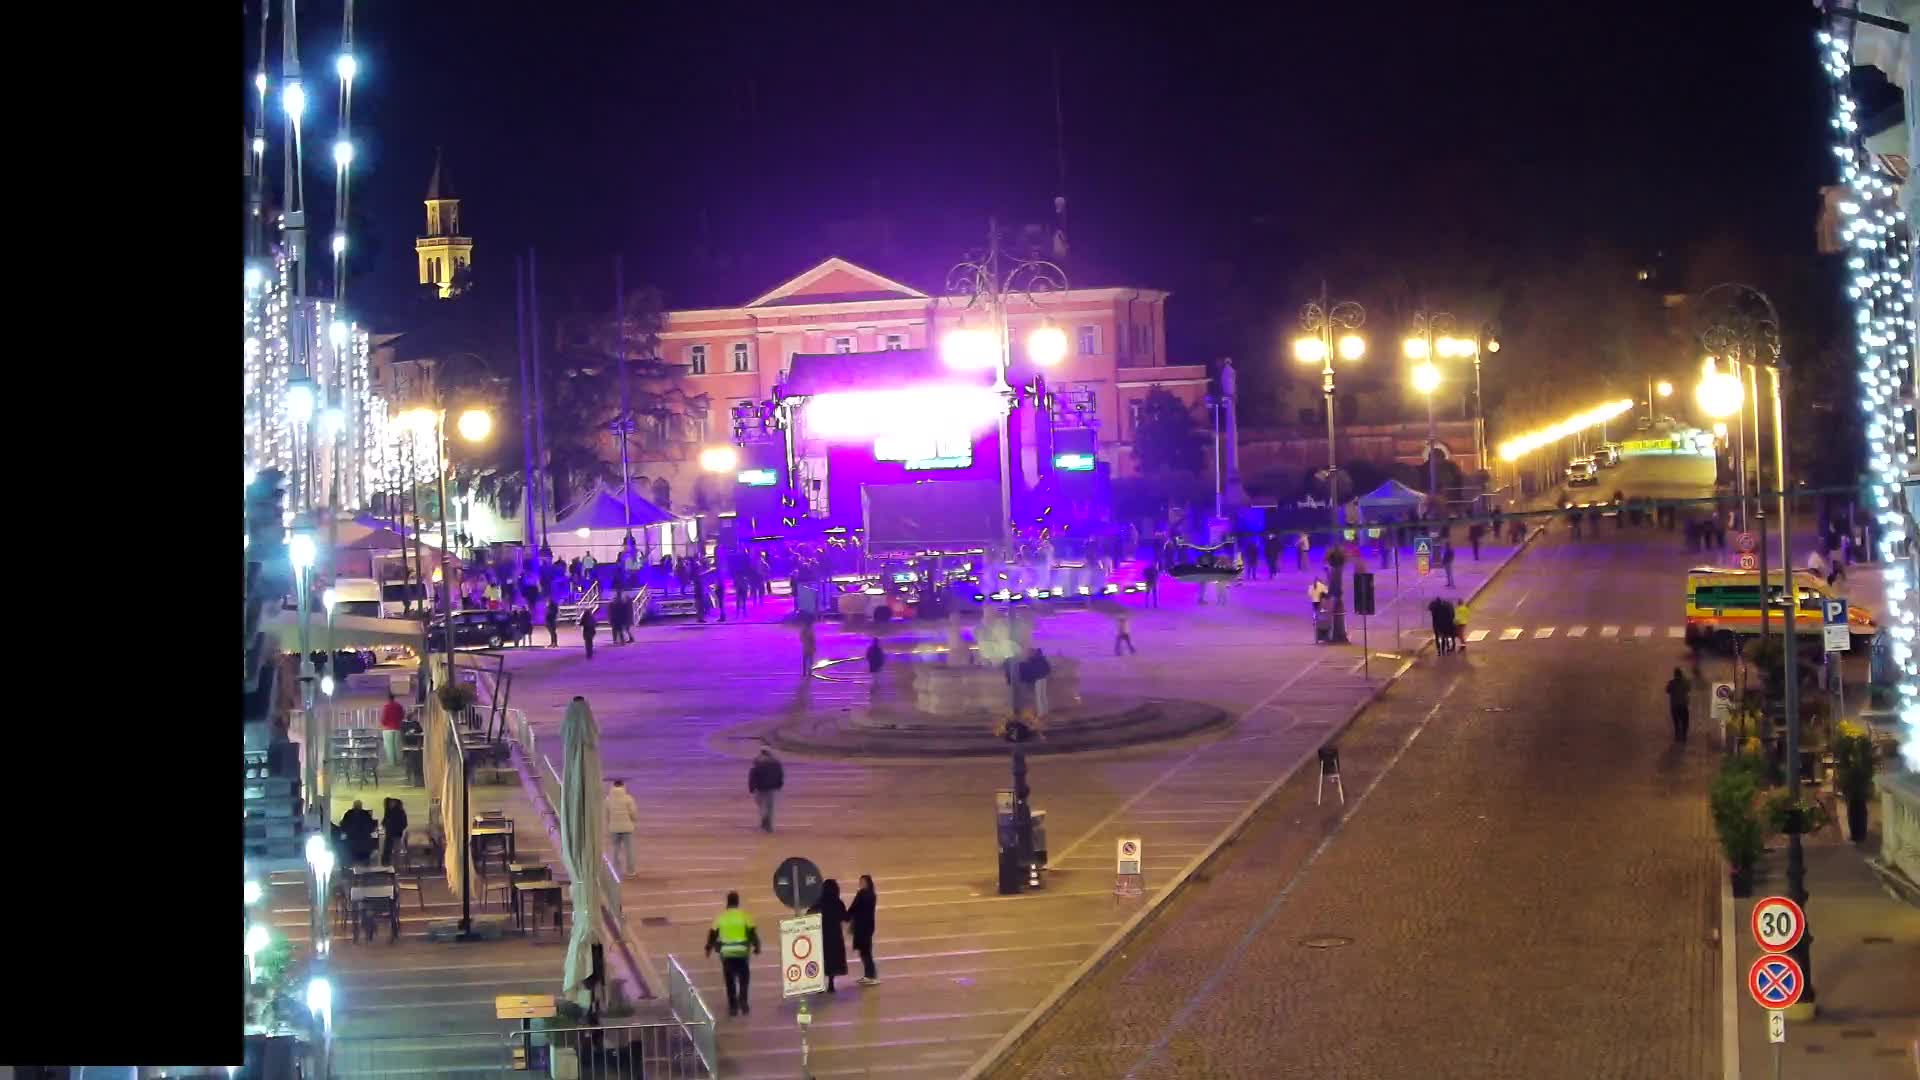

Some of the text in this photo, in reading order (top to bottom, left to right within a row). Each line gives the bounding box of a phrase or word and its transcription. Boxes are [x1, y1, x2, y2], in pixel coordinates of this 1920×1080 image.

[1742, 557, 1753, 567] 20
[1827, 602, 1842, 621] P
[1763, 912, 1791, 937] 30
